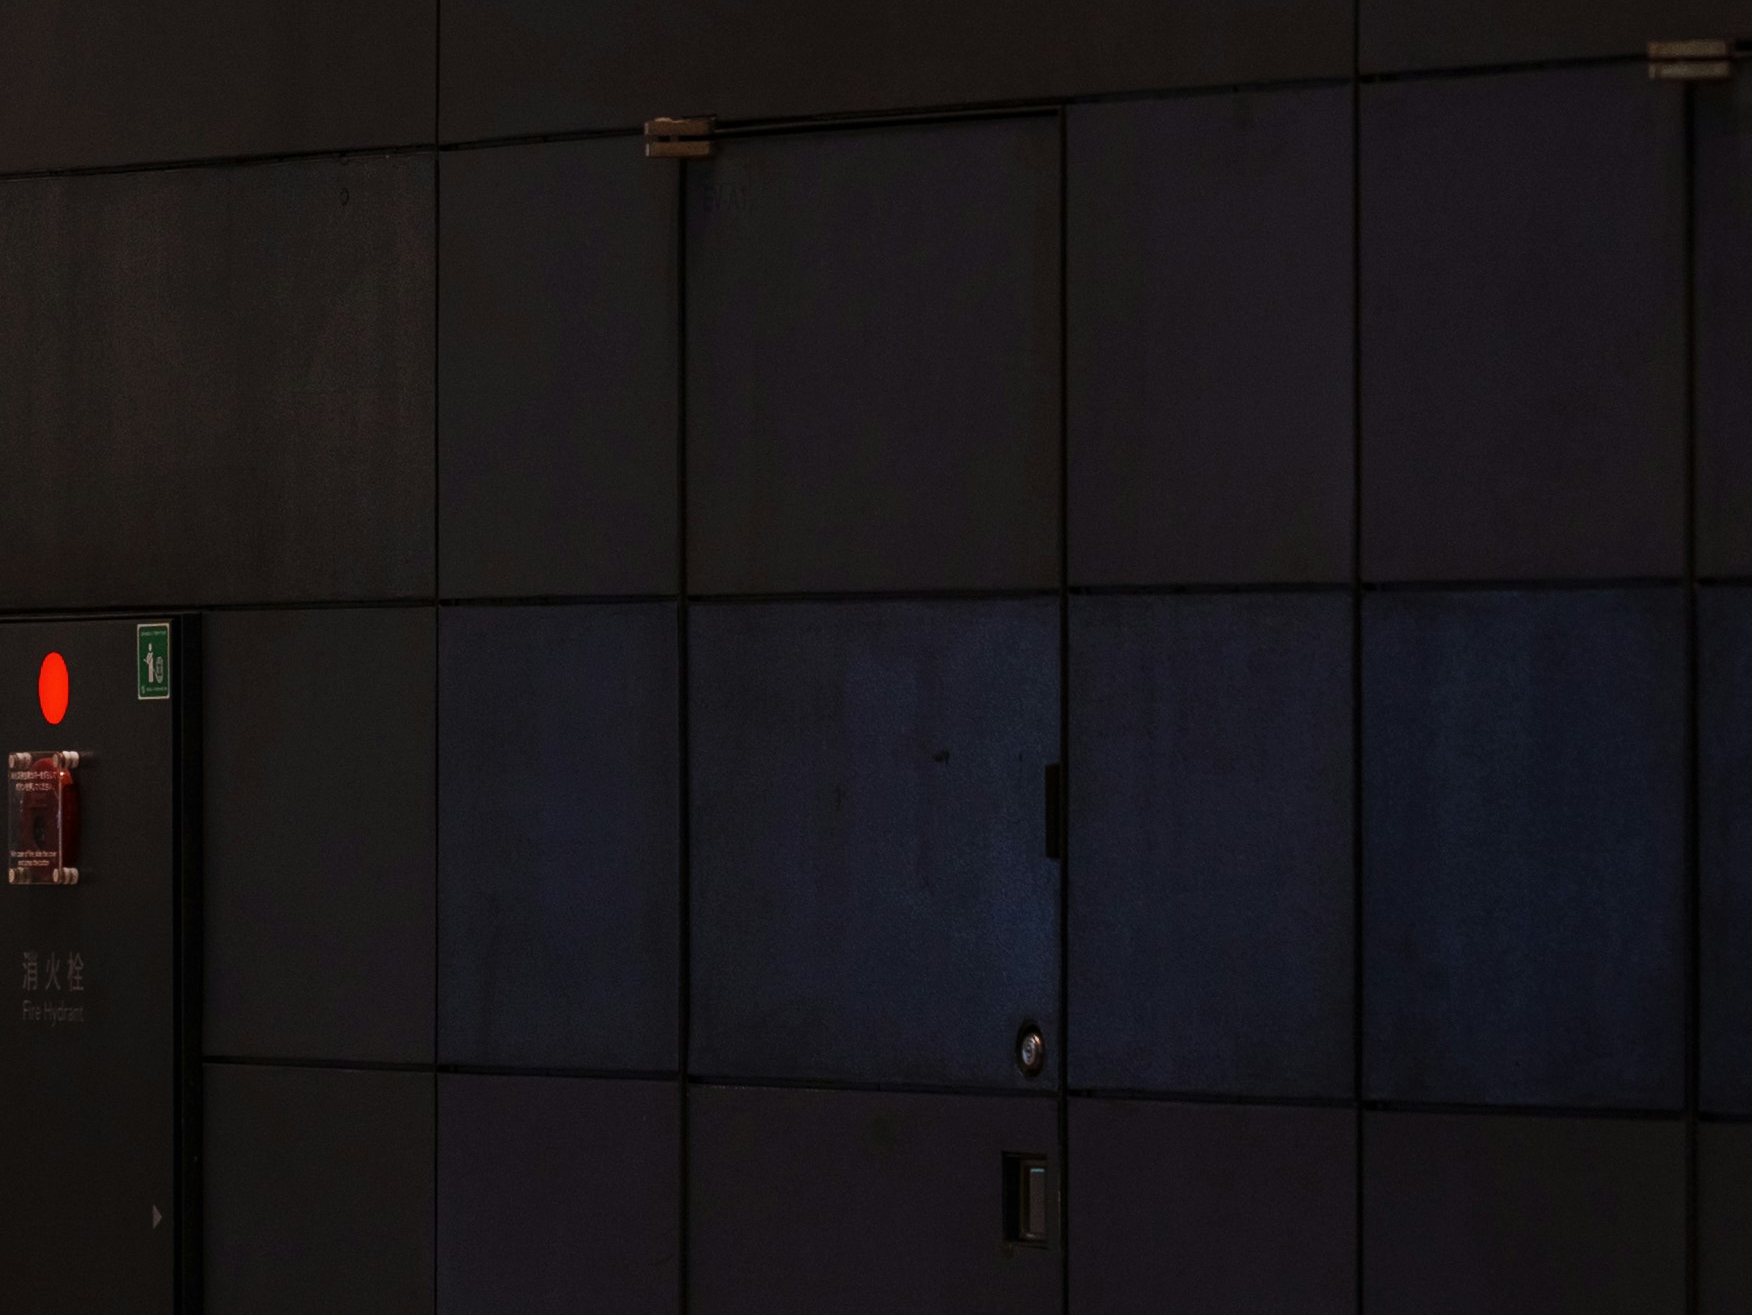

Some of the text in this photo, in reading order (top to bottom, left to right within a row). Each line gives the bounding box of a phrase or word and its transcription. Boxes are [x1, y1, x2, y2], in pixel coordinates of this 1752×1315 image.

[22, 951, 84, 990] 消火栓
[22, 999, 84, 1027] Fire Hydrant
